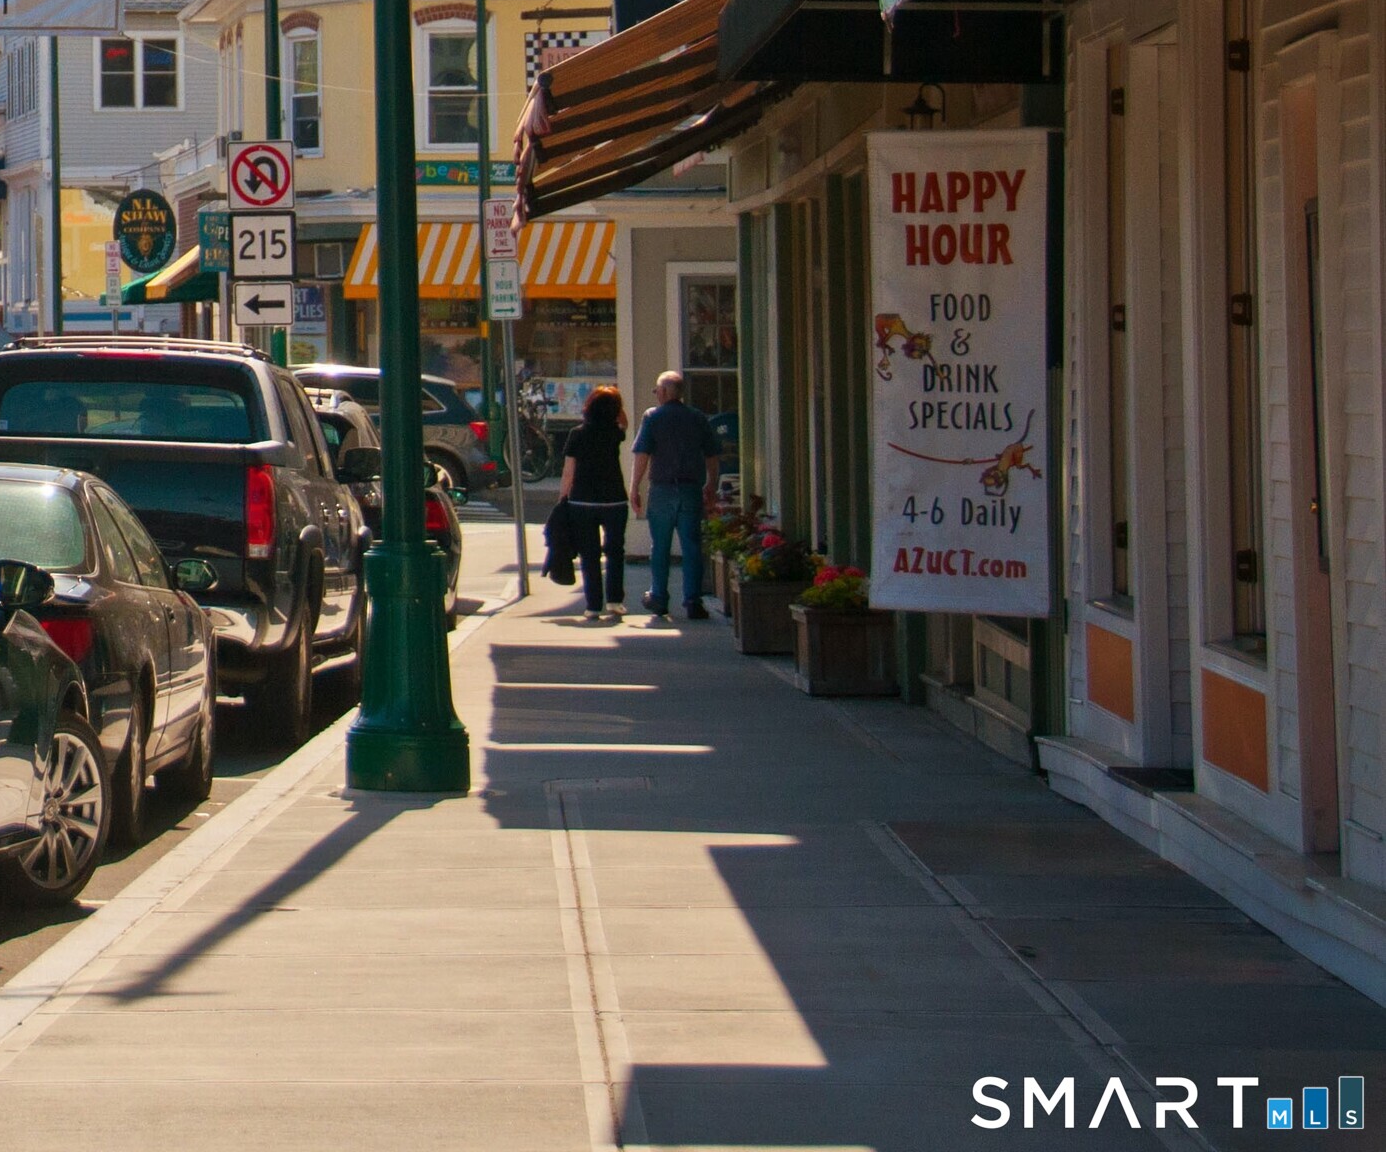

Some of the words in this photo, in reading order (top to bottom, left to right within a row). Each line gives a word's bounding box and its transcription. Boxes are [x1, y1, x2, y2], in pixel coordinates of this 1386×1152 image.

[891, 169, 1026, 213] HAPPY
[122, 210, 166, 224] SHAW
[494, 206, 507, 216] NO
[239, 229, 287, 259] 215
[905, 223, 1014, 266] HOUR
[491, 294, 517, 302] PARKING
[495, 281, 513, 289] HOUR
[930, 293, 991, 322] FOOD
[951, 328, 970, 355] &
[922, 364, 999, 393] DRINK
[908, 401, 1013, 432] SPECIALS
[901, 496, 945, 526] 4-6
[961, 497, 1021, 534] Daily
